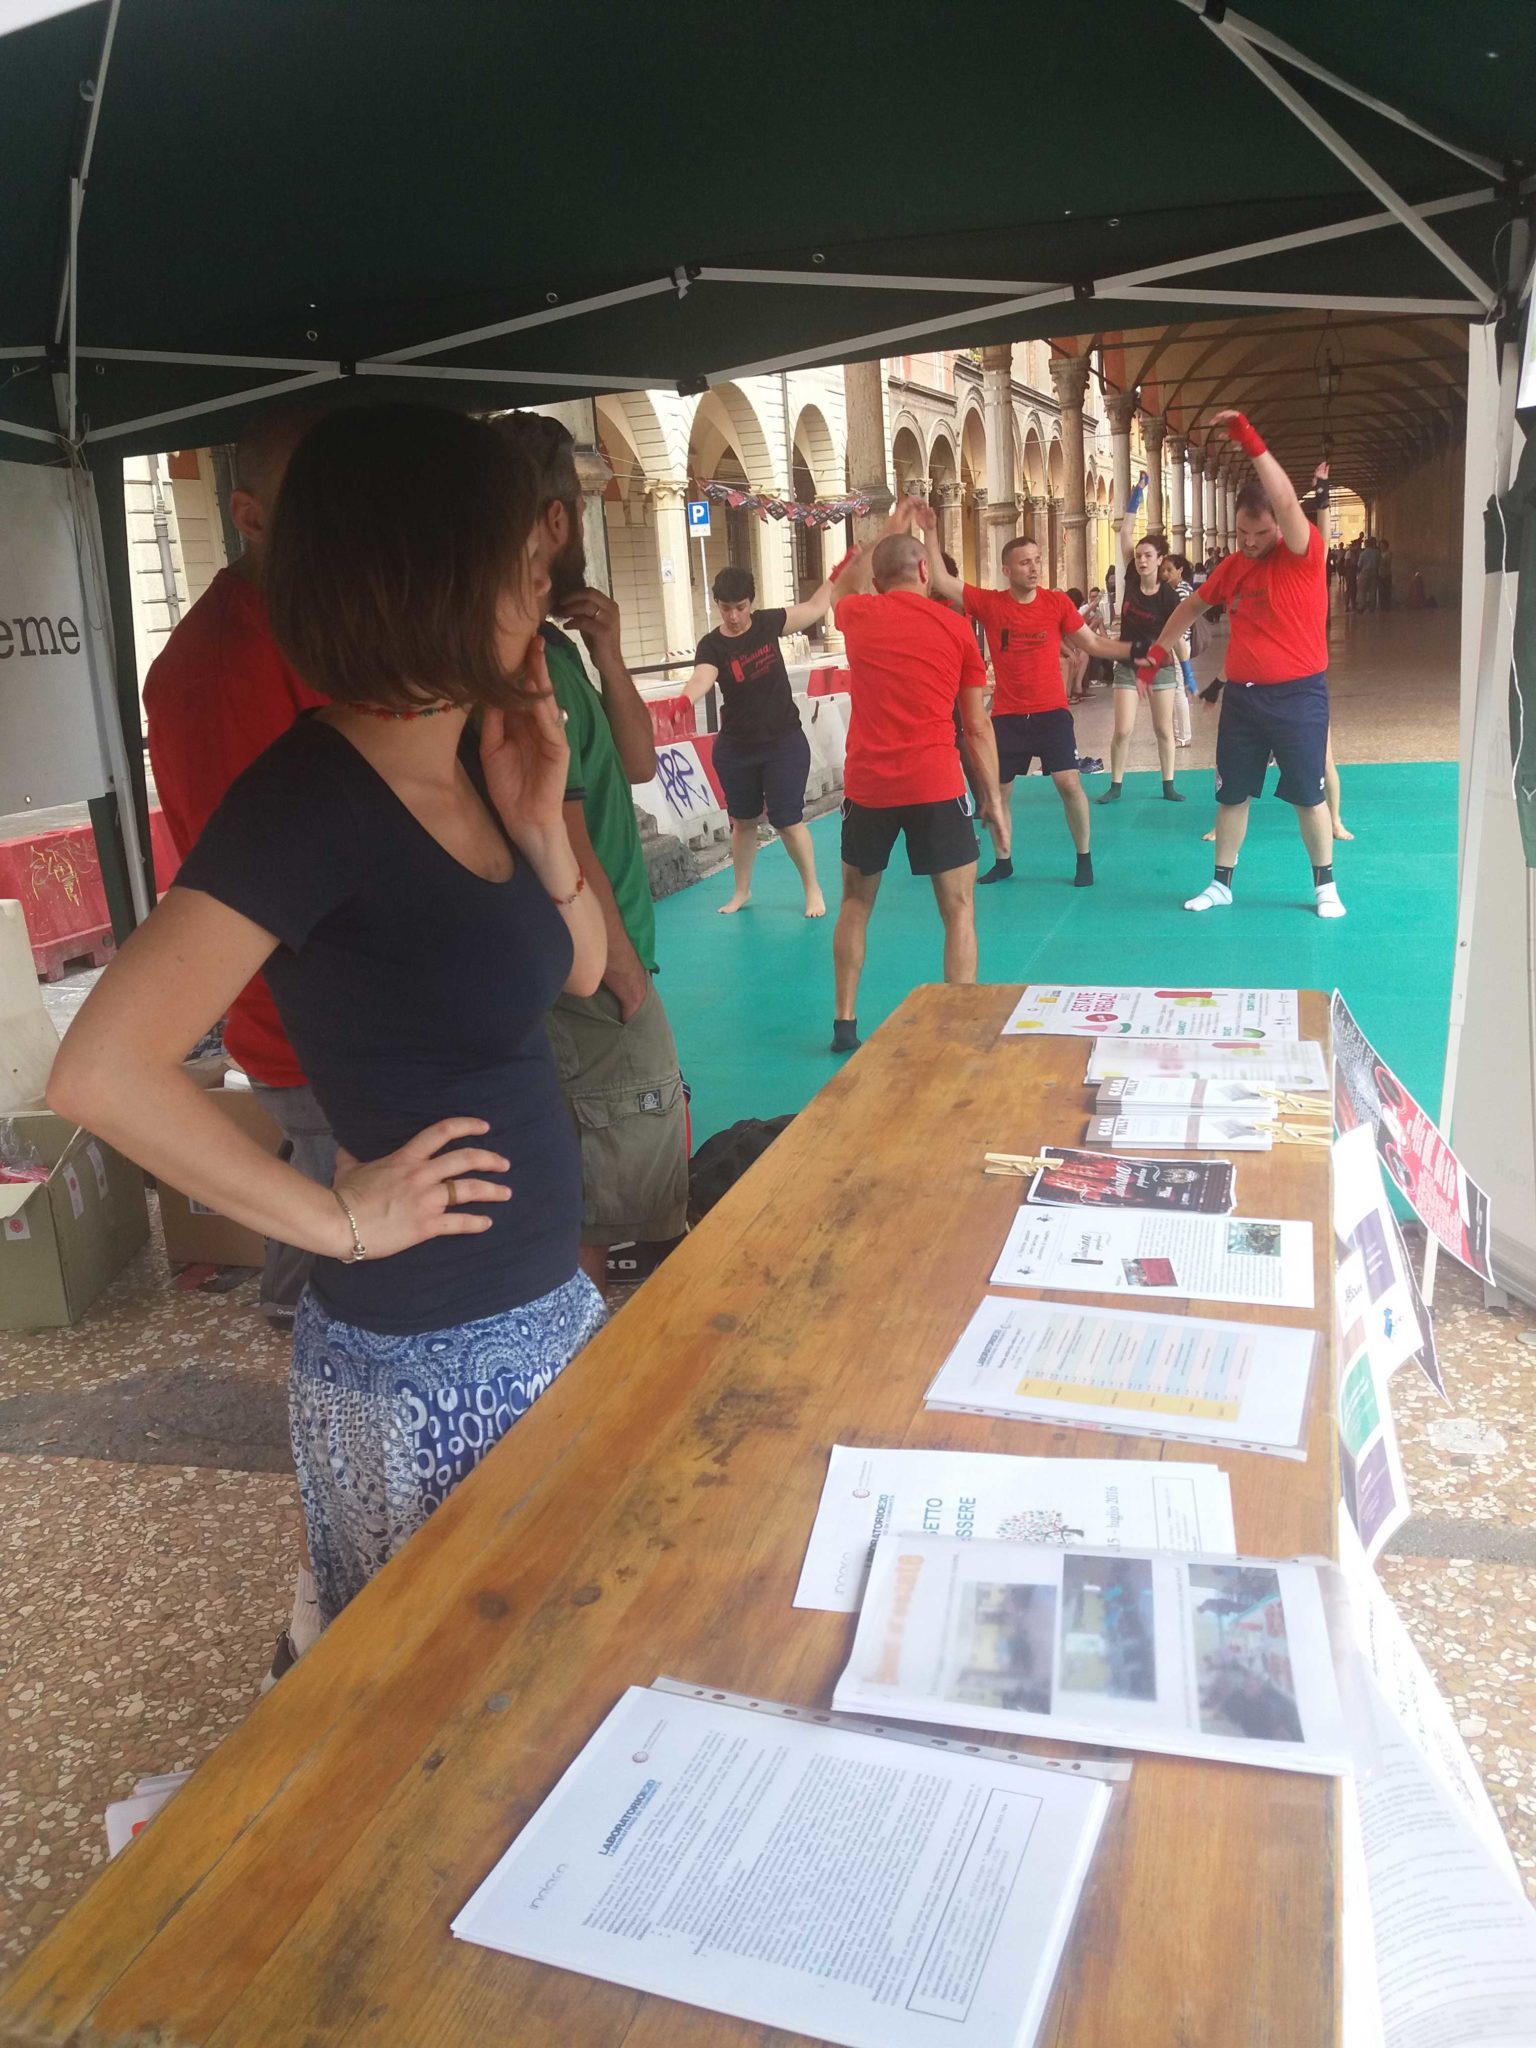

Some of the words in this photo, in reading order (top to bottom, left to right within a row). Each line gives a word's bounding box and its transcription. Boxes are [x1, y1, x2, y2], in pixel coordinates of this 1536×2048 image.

[692, 505, 705, 523] P
[0, 616, 80, 659] eme
[1107, 1079, 1127, 1096] CASA
[1097, 1117, 1116, 1136] CASA
[1114, 1118, 1129, 1136] WILLY
[1105, 1485, 1118, 1504] 2016
[954, 1496, 977, 1541] SSERE
[1106, 1504, 1123, 1528] luglio
